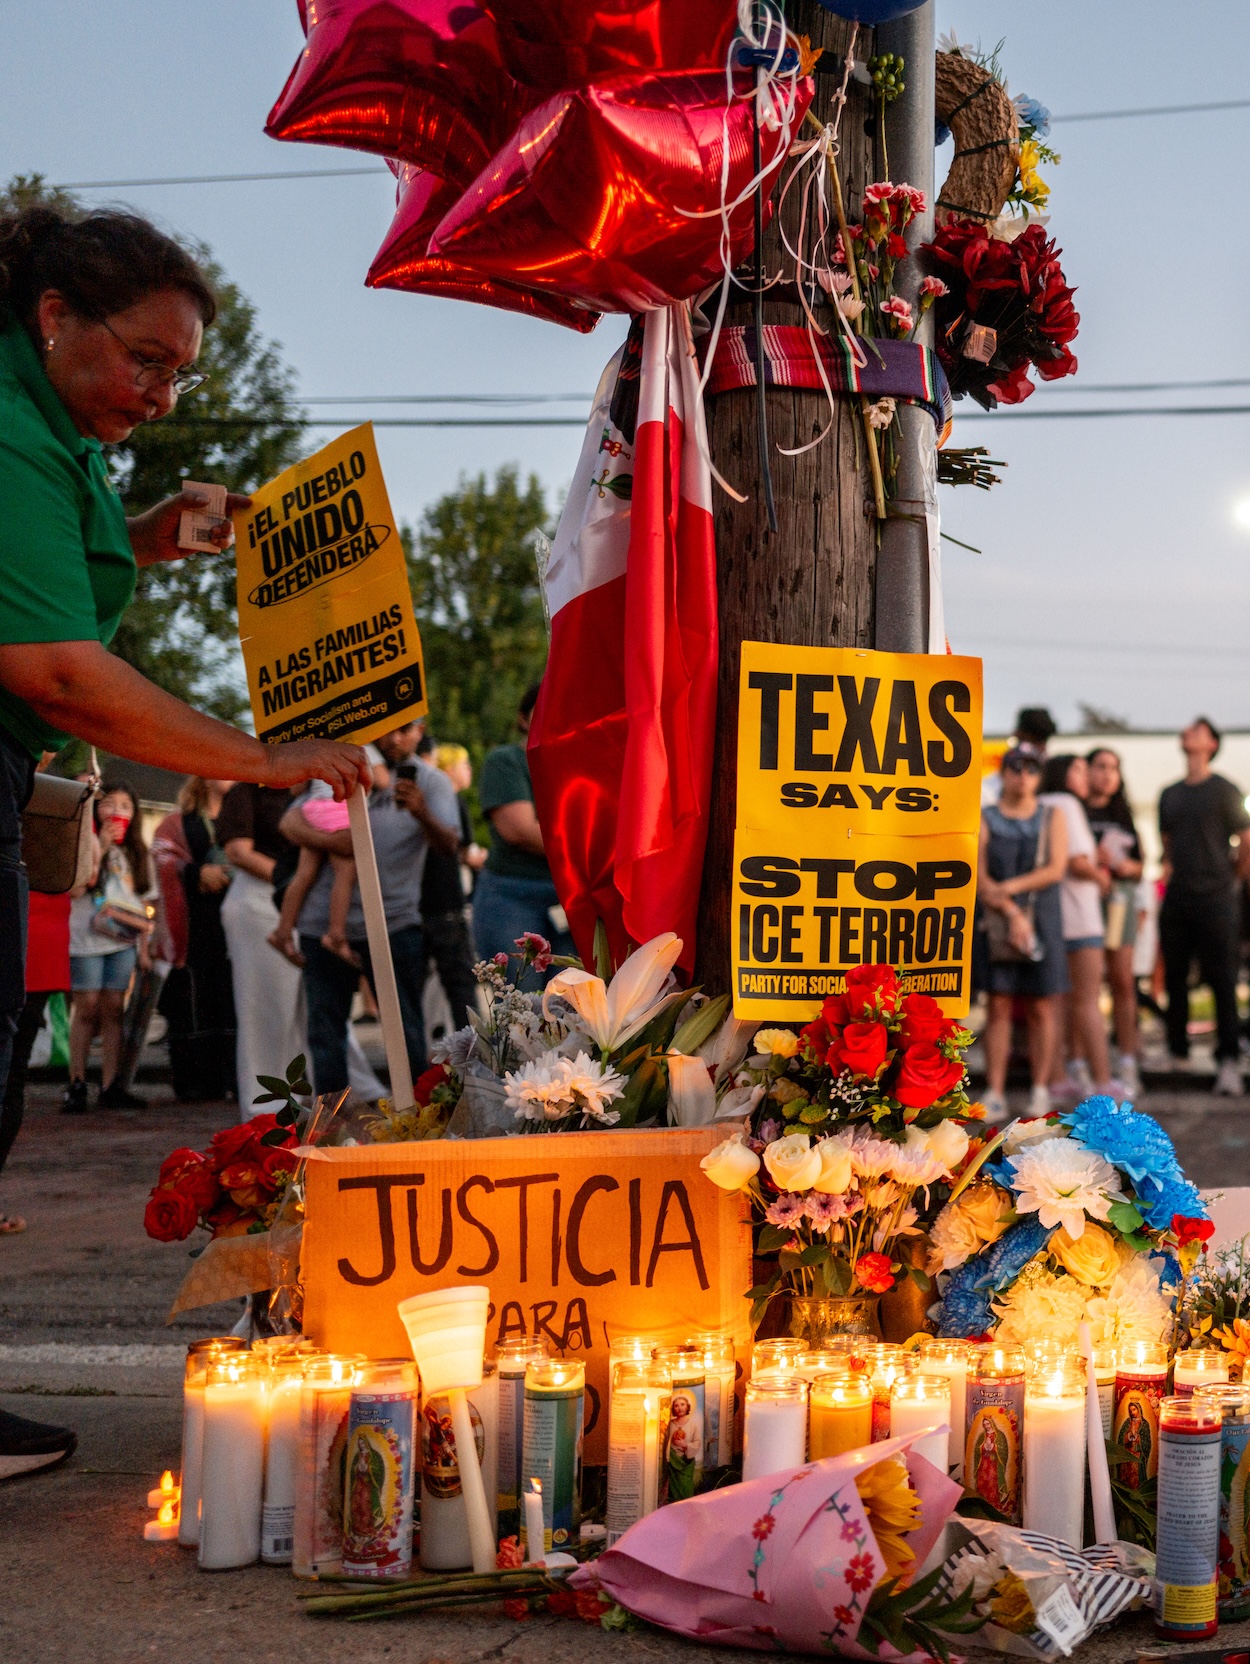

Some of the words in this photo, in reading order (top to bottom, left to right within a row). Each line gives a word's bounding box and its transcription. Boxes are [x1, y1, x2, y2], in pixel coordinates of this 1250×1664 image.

[248, 506, 279, 549] ¡EL
[281, 450, 367, 521] PUEBLO
[261, 489, 365, 579] UNIDO
[258, 522, 380, 609] DEFENDERÁ
[258, 665, 272, 689] A
[275, 647, 312, 680] LAS
[314, 603, 403, 661] FAMILIAS
[261, 628, 408, 718] MIGRANTES!
[267, 729, 292, 745] Party
[292, 722, 307, 734] for
[307, 701, 351, 729] Socialism
[351, 691, 373, 708] and
[327, 702, 389, 734] PSLWeb.org
[748, 671, 972, 778] TEXAS
[780, 782, 939, 812] SAYS:
[739, 855, 972, 902] STOP
[739, 904, 804, 963] ICE
[813, 904, 967, 965] TERROR
[741, 973, 781, 994] PARTY
[782, 975, 810, 994] FOR
[809, 975, 848, 995] SOCIA
[903, 972, 958, 995] BERATION
[338, 1173, 710, 1290] JUSTICIA
[737, 1220, 747, 1244] Than
